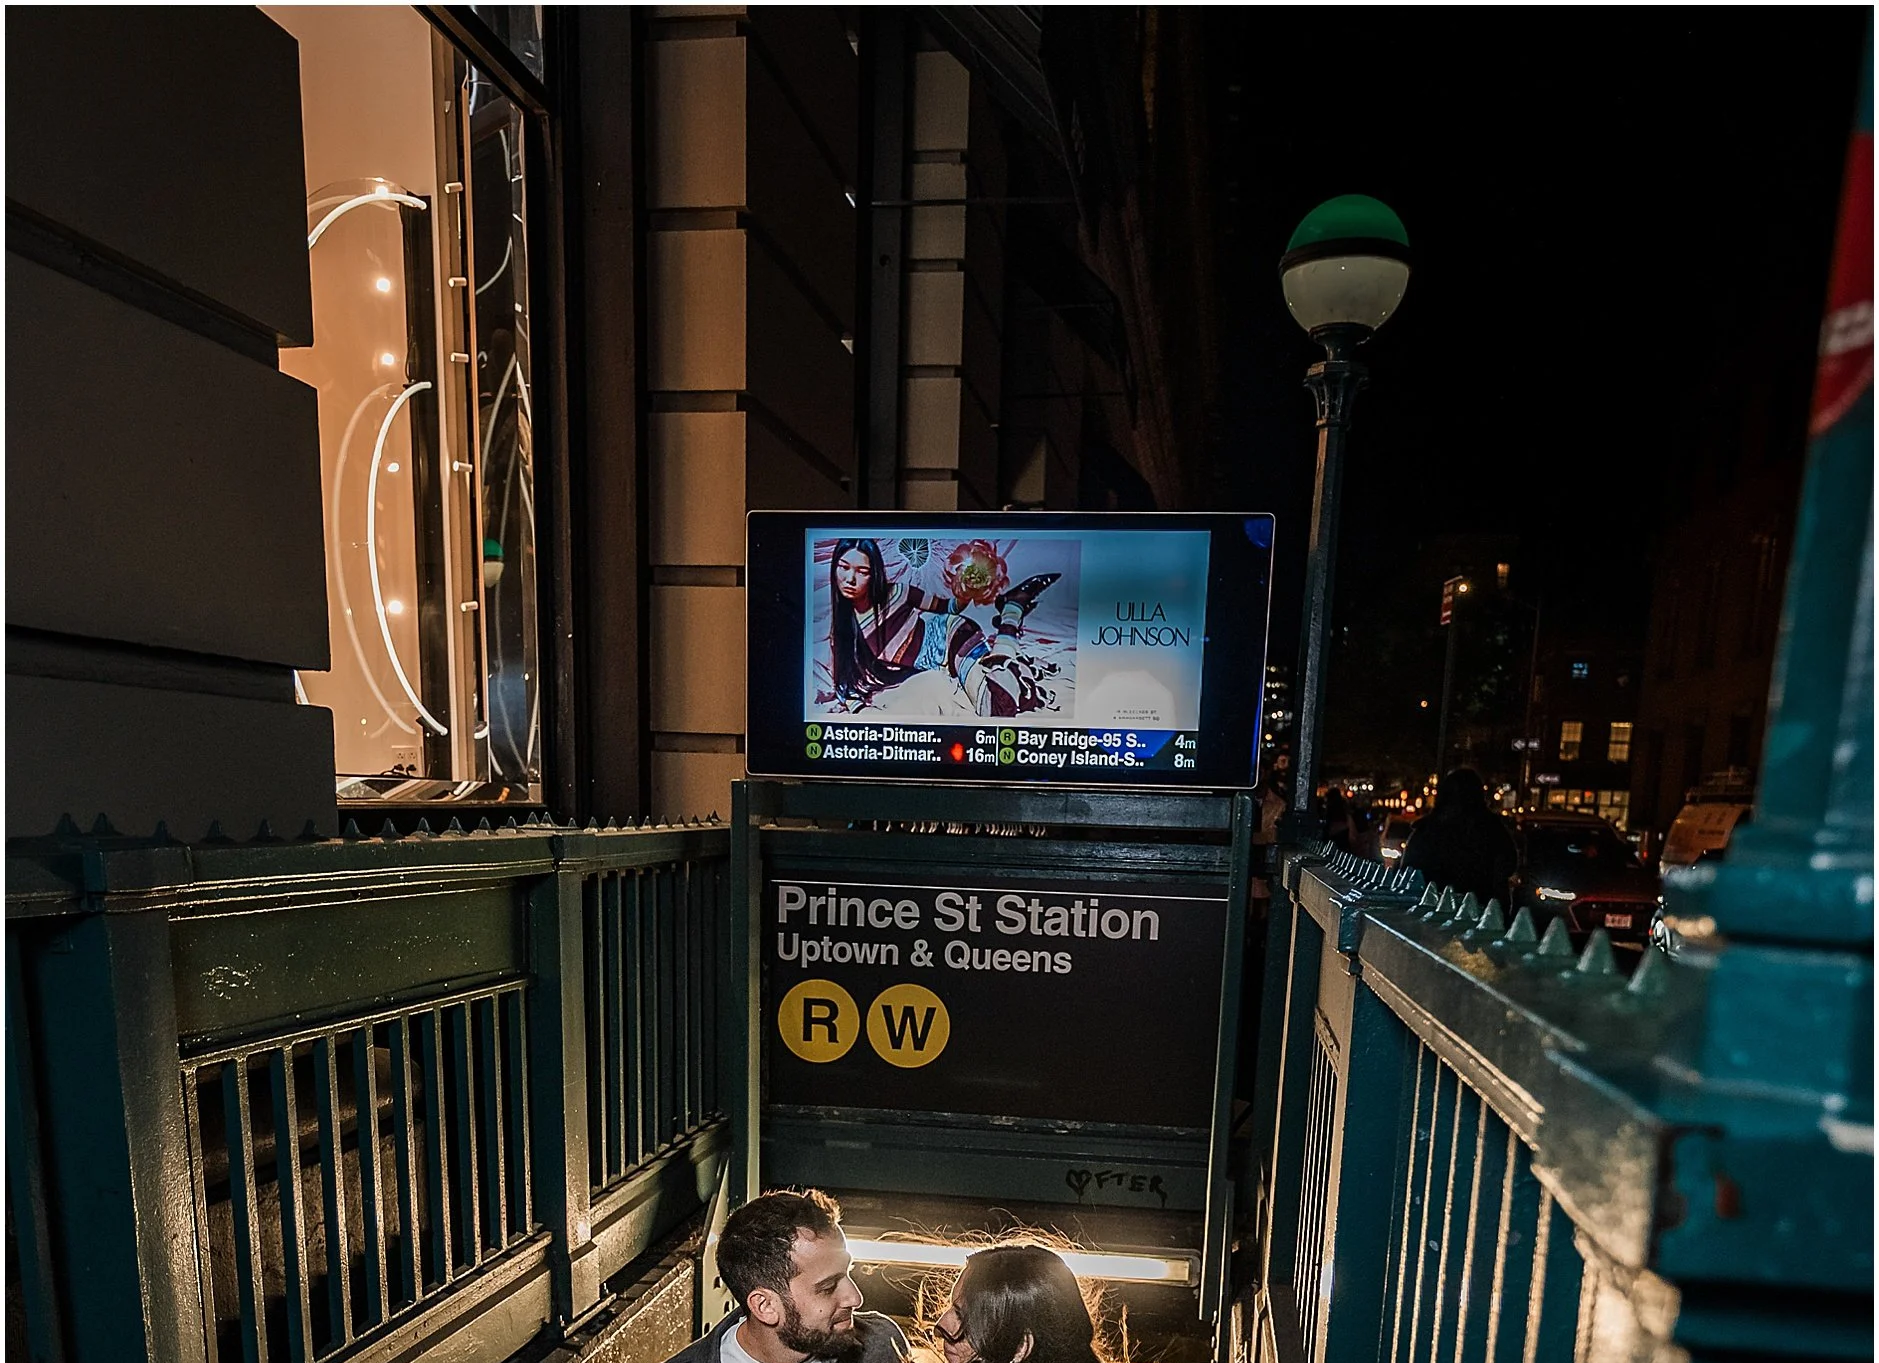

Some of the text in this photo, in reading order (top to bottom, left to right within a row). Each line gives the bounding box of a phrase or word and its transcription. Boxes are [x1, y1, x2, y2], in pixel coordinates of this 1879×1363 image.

[1116, 602, 1166, 622] ULLA
[1091, 626, 1191, 647] JOHNSON
[823, 726, 942, 743] Astoria-Ditmar..
[975, 730, 996, 745] 6m
[1017, 731, 1050, 749] Bay
[1052, 732, 1122, 750] Ridge-95
[1175, 735, 1196, 749] 4m
[823, 744, 942, 762] Astoria-Ditmar..
[966, 748, 995, 763] 16m
[1017, 749, 1066, 768] Coney
[1174, 754, 1195, 768] 8m
[777, 886, 1160, 941] Prince St Station
[777, 933, 1073, 974] Uptown & Queens
[801, 997, 937, 1052] R W
